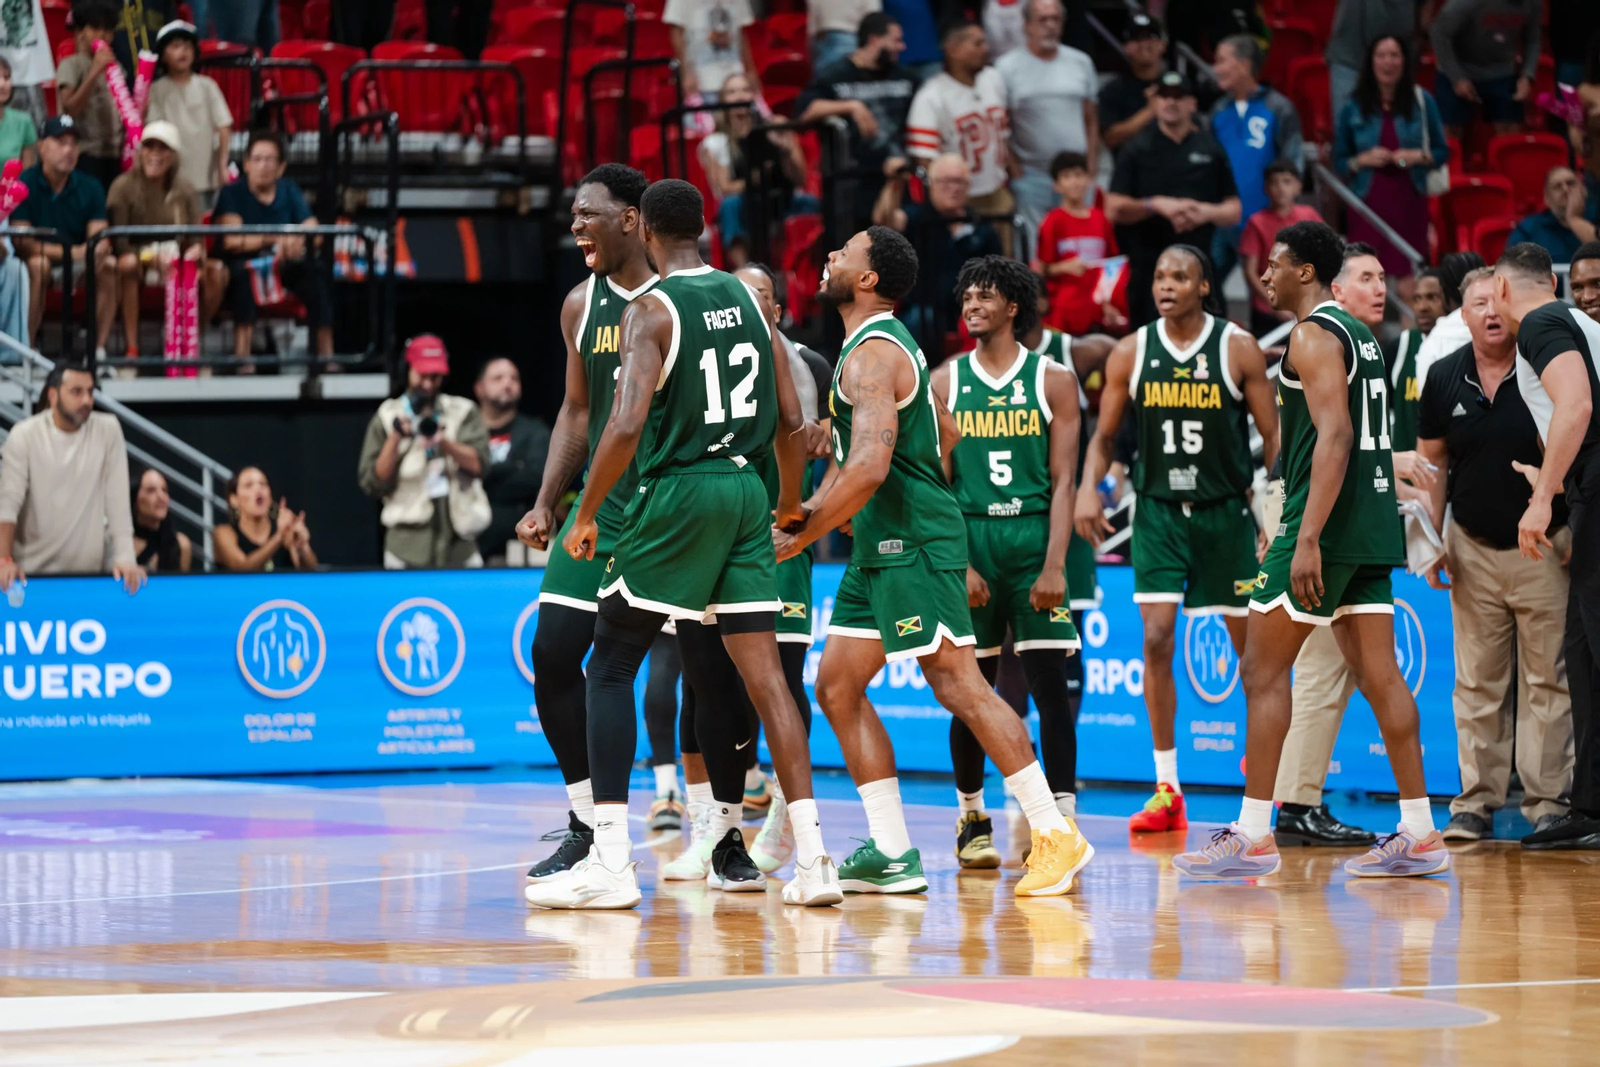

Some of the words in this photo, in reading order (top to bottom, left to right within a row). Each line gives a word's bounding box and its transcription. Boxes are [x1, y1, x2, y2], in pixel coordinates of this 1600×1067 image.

[703, 306, 743, 331] FACEY
[699, 342, 760, 424] 12
[1143, 381, 1222, 409] JAMAICA
[955, 409, 1041, 438] JAMAICA
[1360, 378, 1391, 450] 17
[1161, 419, 1203, 455] 15
[988, 450, 1013, 486] 5
[0, 618, 107, 656] IVIO
